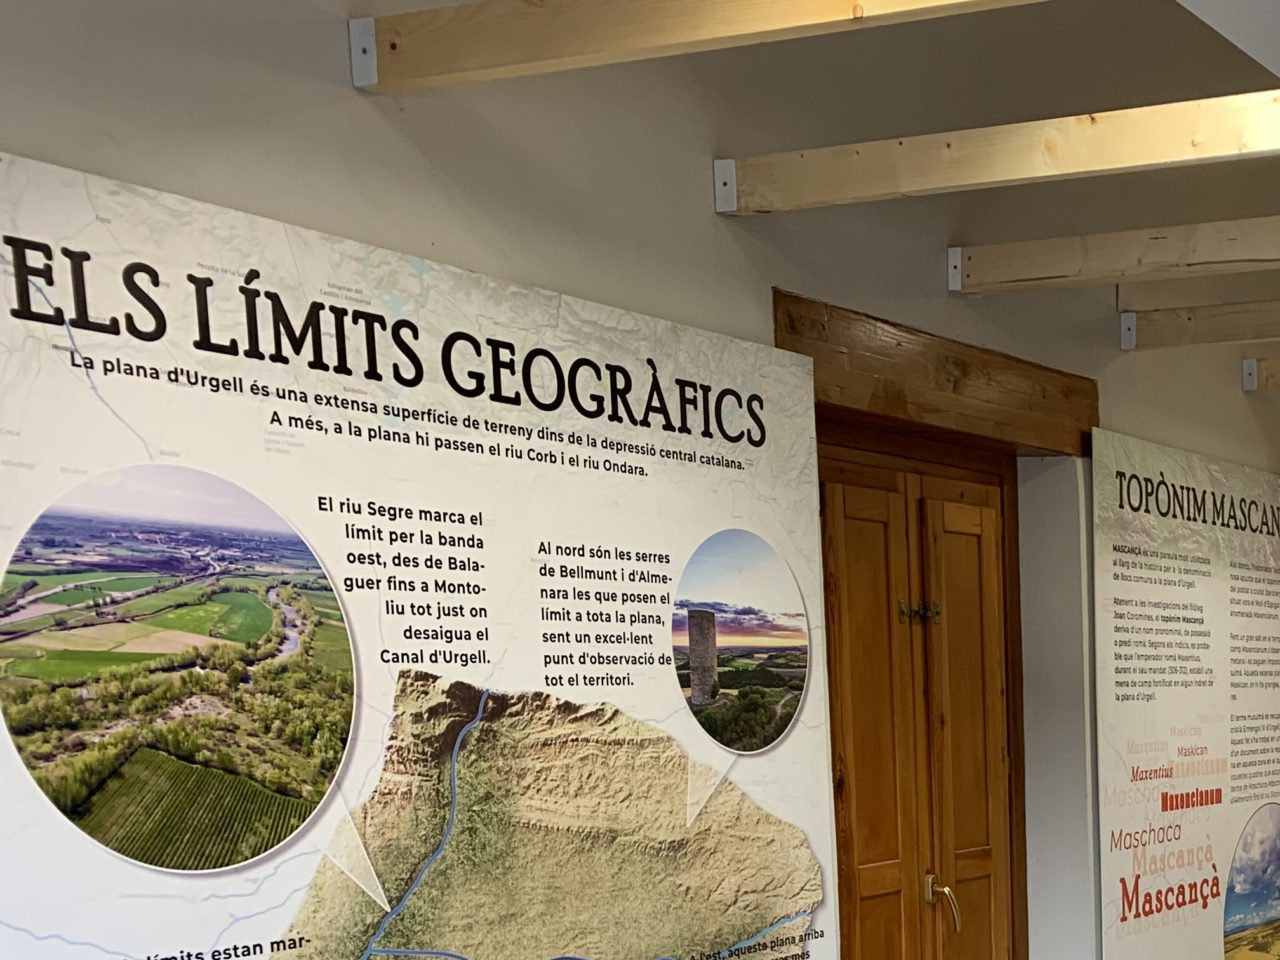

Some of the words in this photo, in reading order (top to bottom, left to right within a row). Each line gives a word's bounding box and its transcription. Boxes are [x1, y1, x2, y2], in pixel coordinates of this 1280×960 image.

[2, 235, 167, 342] ELS
[187, 268, 424, 388] LÍMITS
[441, 331, 766, 447] GEOGRÀFICS
[69, 350, 95, 370] La
[102, 357, 160, 380] plana
[167, 367, 244, 393] d'Urgell
[249, 379, 270, 397] és
[275, 387, 308, 404] una
[313, 393, 378, 415] extensa
[382, 404, 458, 427] superfície
[462, 414, 480, 430] de
[483, 419, 534, 441] terreny
[536, 426, 564, 443] dins
[567, 431, 583, 446] de
[586, 433, 597, 448] la
[600, 436, 657, 457] depressió
[659, 448, 697, 463] central
[699, 455, 745, 471] catalana.
[269, 410, 283, 426] A
[288, 414, 329, 435] més,
[333, 422, 343, 435] a
[348, 420, 362, 438] la
[367, 425, 411, 444] plana
[415, 430, 430, 447] hi
[434, 437, 484, 455] passen
[488, 442, 501, 457] el
[505, 444, 523, 460] riu
[526, 448, 557, 464] Corb
[568, 454, 580, 468] el
[583, 455, 600, 470] riu
[603, 459, 648, 477] Ondara.
[1116, 471, 1207, 525] TOPÒNIM
[317, 496, 334, 512] El
[339, 497, 362, 515] riu
[367, 501, 414, 522] Segre
[418, 509, 466, 525] marca
[469, 511, 483, 526] el
[345, 523, 384, 542] límit
[388, 530, 415, 546] per
[419, 529, 433, 545] la
[438, 531, 484, 550] banda
[346, 552, 387, 569] oest,
[391, 551, 420, 568] des
[424, 554, 443, 570] de
[447, 556, 485, 572] Bala-
[537, 541, 552, 555] Al
[555, 544, 585, 558] nord
[589, 545, 611, 560] són
[614, 547, 632, 561] les
[635, 551, 671, 564] serres
[539, 563, 556, 578] de
[559, 564, 618, 582] Bellmunt
[628, 569, 673, 585] d'Alme-
[343, 577, 382, 593] guer
[386, 575, 416, 592] fins
[420, 581, 429, 593] a
[434, 579, 486, 595] Monto-
[540, 588, 569, 600] nara
[572, 586, 591, 601] les
[594, 591, 618, 605] que
[621, 591, 658, 605] posen
[659, 591, 670, 605] el
[385, 599, 405, 616] liu
[409, 602, 433, 617] tot
[436, 601, 466, 620] just
[469, 607, 488, 618] on
[541, 607, 572, 622] límit
[575, 611, 583, 622] a
[586, 610, 612, 623] tota
[615, 610, 626, 624] la
[629, 610, 665, 627] plana,
[403, 625, 472, 644] desaigua
[476, 627, 489, 641] el
[542, 631, 571, 644] sent
[574, 633, 591, 644] un
[594, 631, 654, 645] excel·lent
[380, 649, 424, 664] Canal
[429, 649, 491, 667] d'Urgell.
[543, 652, 575, 668] punt
[578, 651, 655, 665] d'observació
[657, 652, 673, 665] de
[544, 674, 564, 687] tot
[567, 673, 579, 687] el
[582, 672, 634, 687] territori.
[1177, 744, 1208, 758] Maskican
[1130, 764, 1174, 782] Maxentius
[1109, 822, 1182, 852] Maschaca
[1119, 863, 1221, 922] Mascançà
[270, 936, 312, 953] mar-
[728, 944, 768, 959] aquesta
[770, 936, 796, 950] plana
[799, 929, 824, 943] arriba
[792, 950, 810, 960] més
